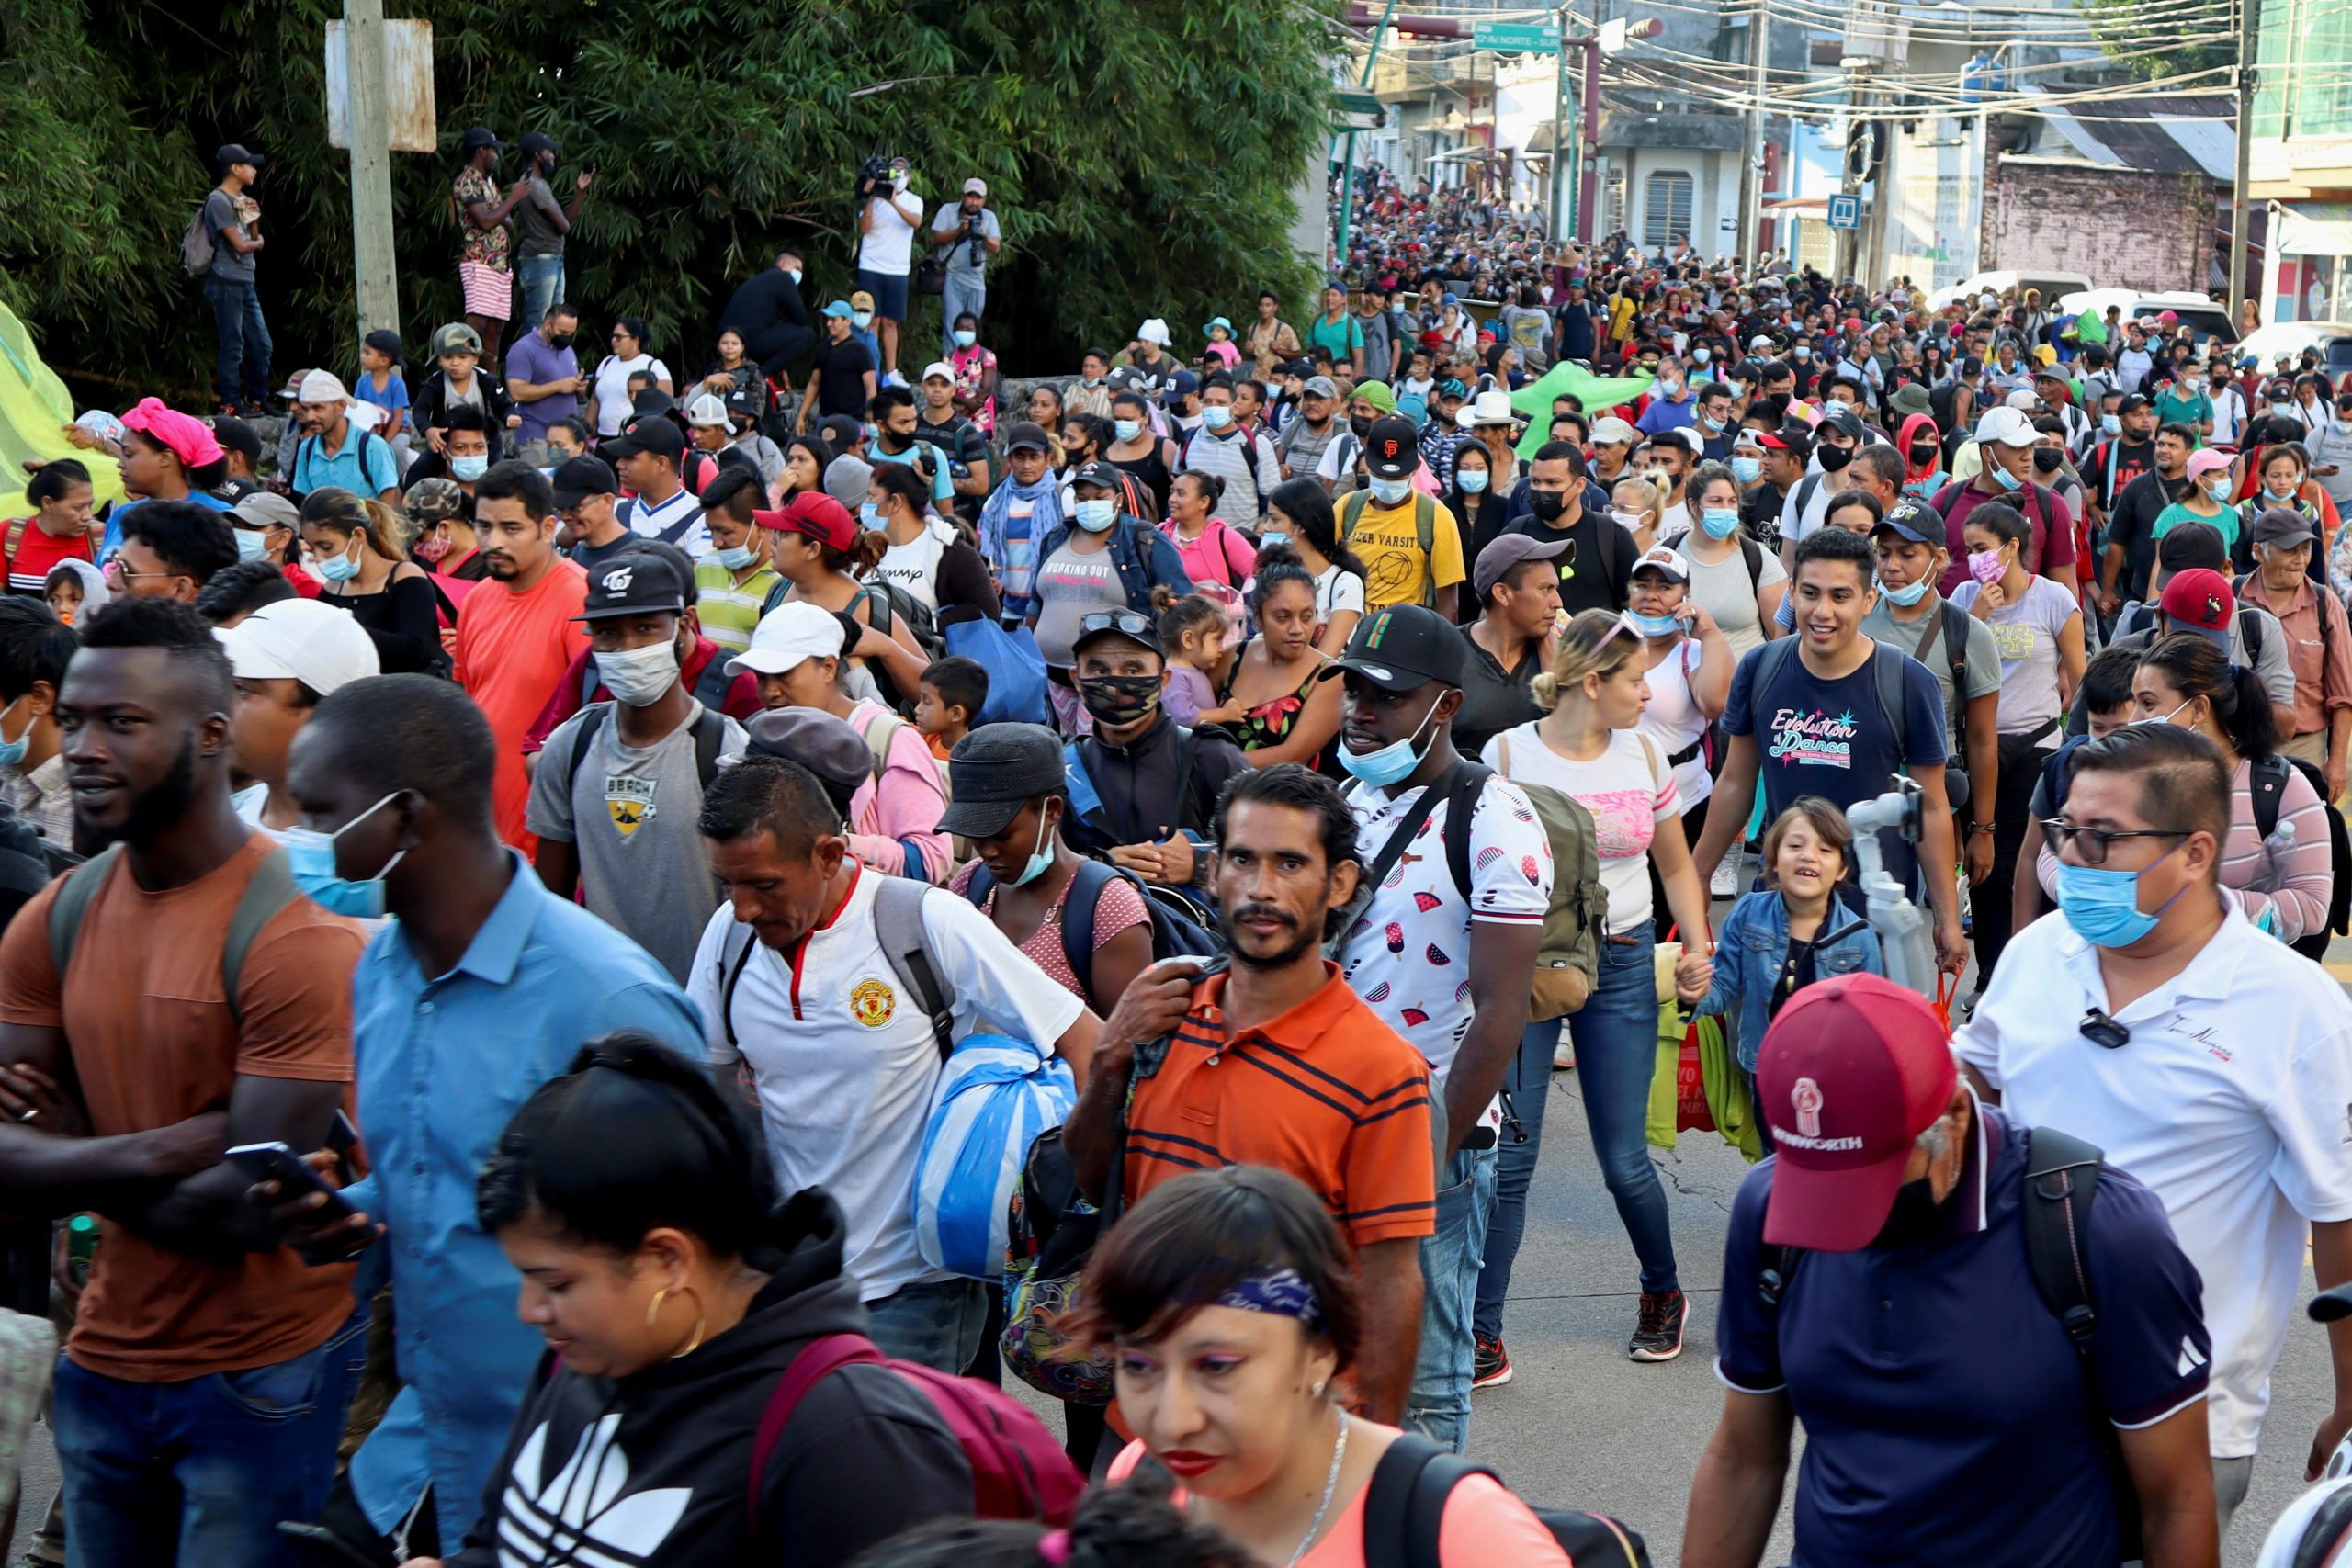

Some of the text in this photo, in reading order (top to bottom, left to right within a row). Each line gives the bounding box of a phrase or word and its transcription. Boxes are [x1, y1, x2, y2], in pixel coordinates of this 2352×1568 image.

[1499, 36, 1532, 46] NORTE
[1539, 38, 1559, 47] SUR
[1046, 562, 1109, 578] WORKING OUT
[1771, 708, 1857, 738] Evolution
[1769, 730, 1850, 758] Dance
